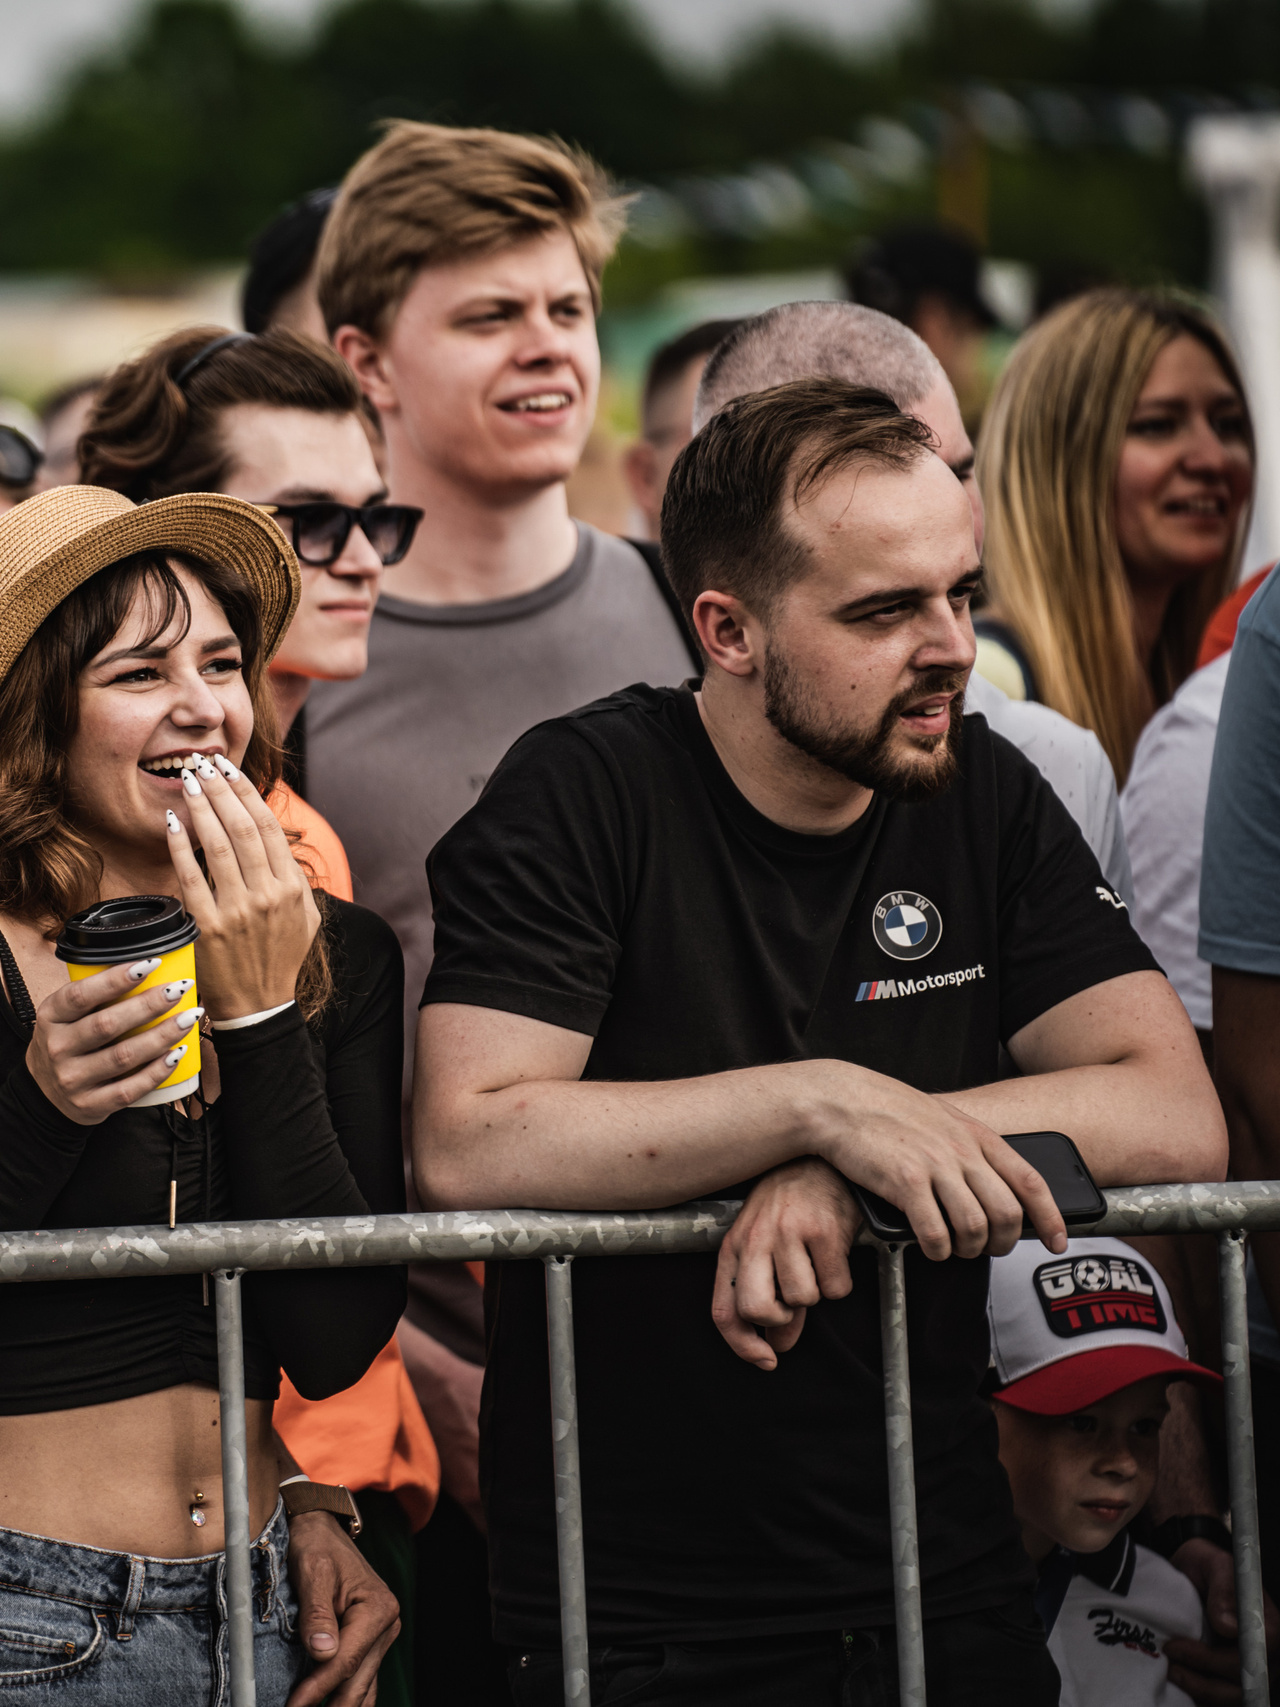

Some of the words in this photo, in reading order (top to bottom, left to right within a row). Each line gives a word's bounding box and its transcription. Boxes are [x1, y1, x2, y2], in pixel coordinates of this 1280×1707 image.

[875, 893, 930, 919] BMW
[897, 964, 985, 997] Motorsport
[1040, 1259, 1153, 1299] GOAL
[1051, 1296, 1157, 1329] TIME
